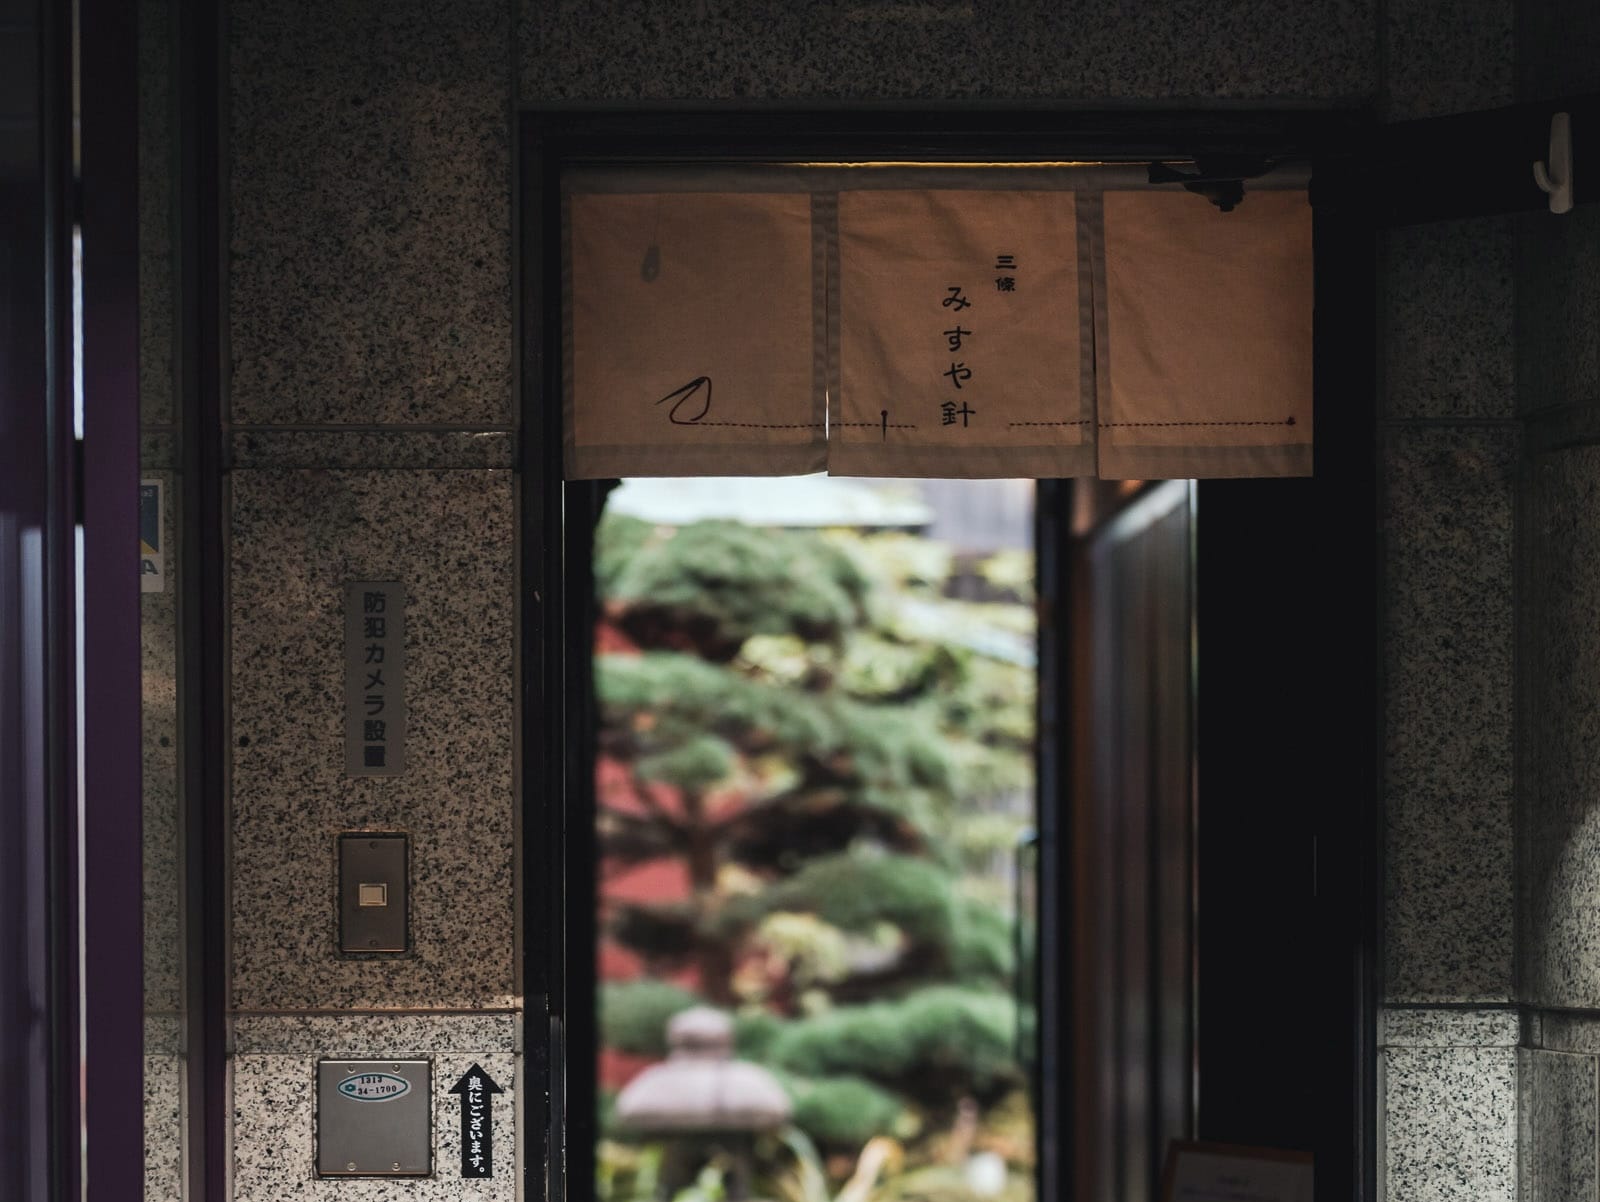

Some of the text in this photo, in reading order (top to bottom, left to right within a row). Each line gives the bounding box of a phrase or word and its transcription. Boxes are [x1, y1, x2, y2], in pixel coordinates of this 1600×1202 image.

[995, 255, 1017, 292] 三條
[941, 287, 976, 428] みすや針
[468, 1075, 485, 1173] 奥にございます。
